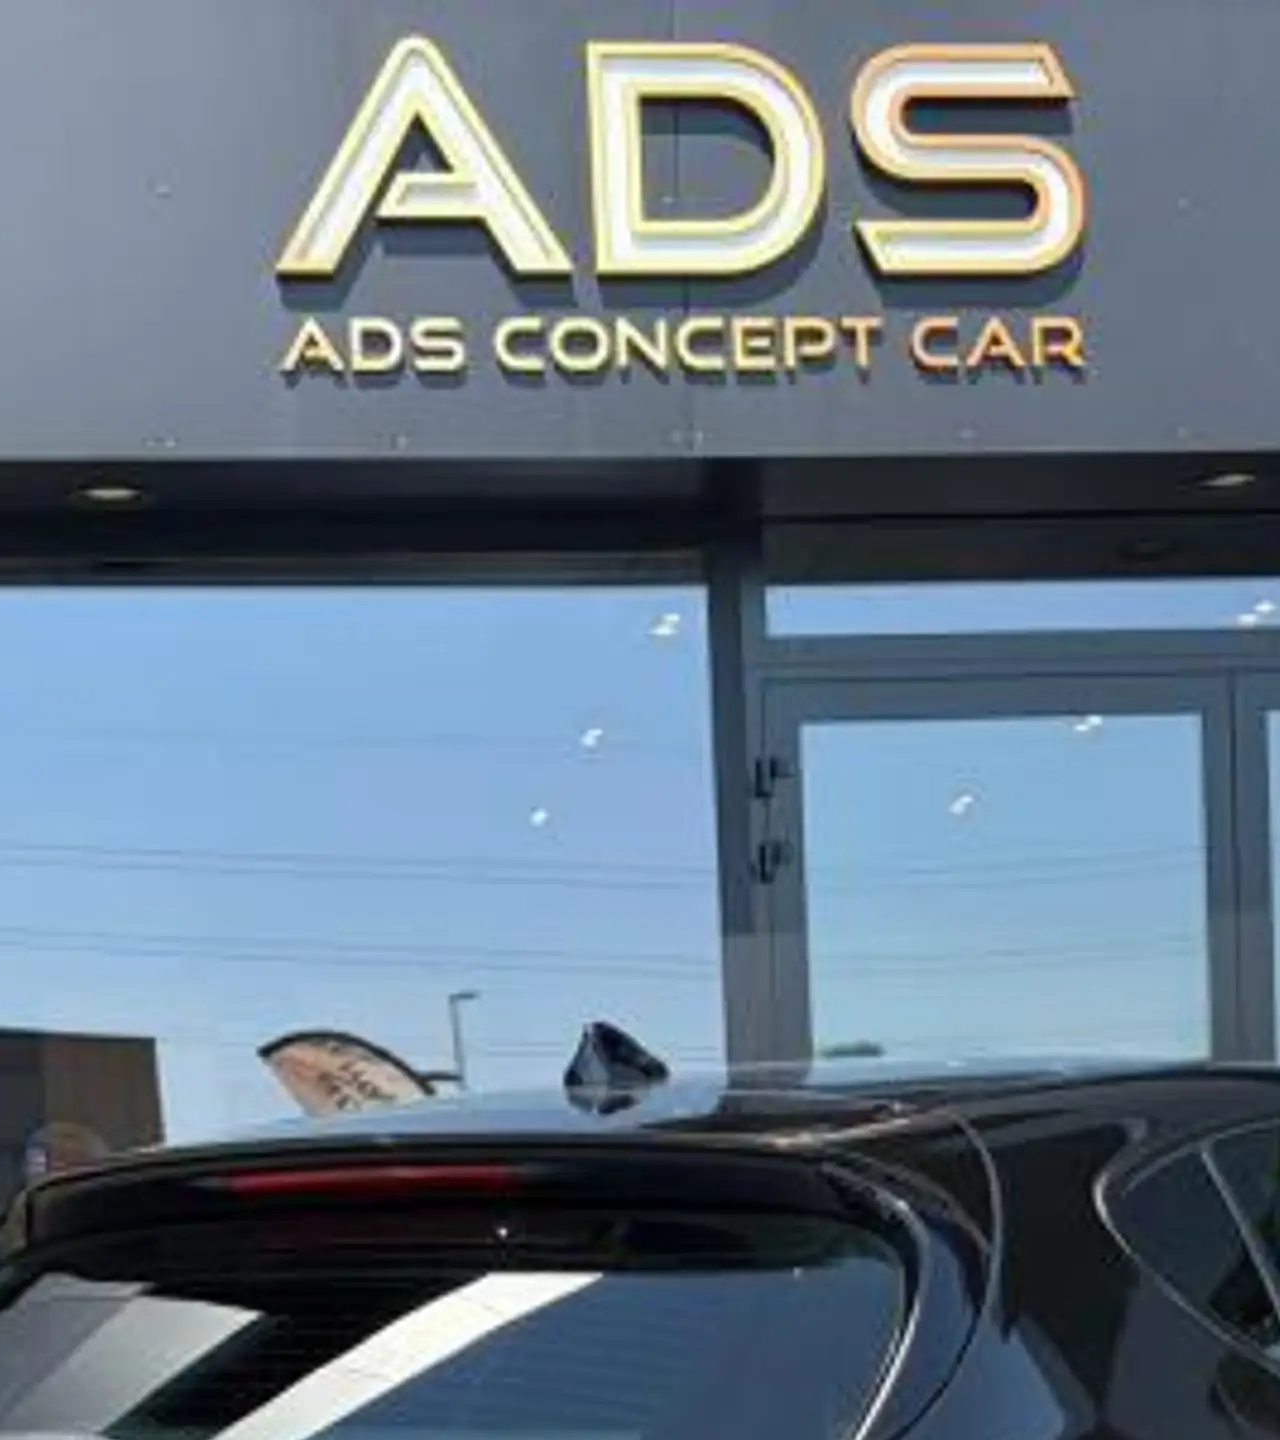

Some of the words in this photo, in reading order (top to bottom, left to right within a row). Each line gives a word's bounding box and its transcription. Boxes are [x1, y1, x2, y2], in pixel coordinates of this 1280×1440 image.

[276, 34, 1085, 277] ADS
[281, 316, 466, 373] ADS
[493, 316, 884, 372] CONCEPT
[912, 316, 1087, 370] CAR
